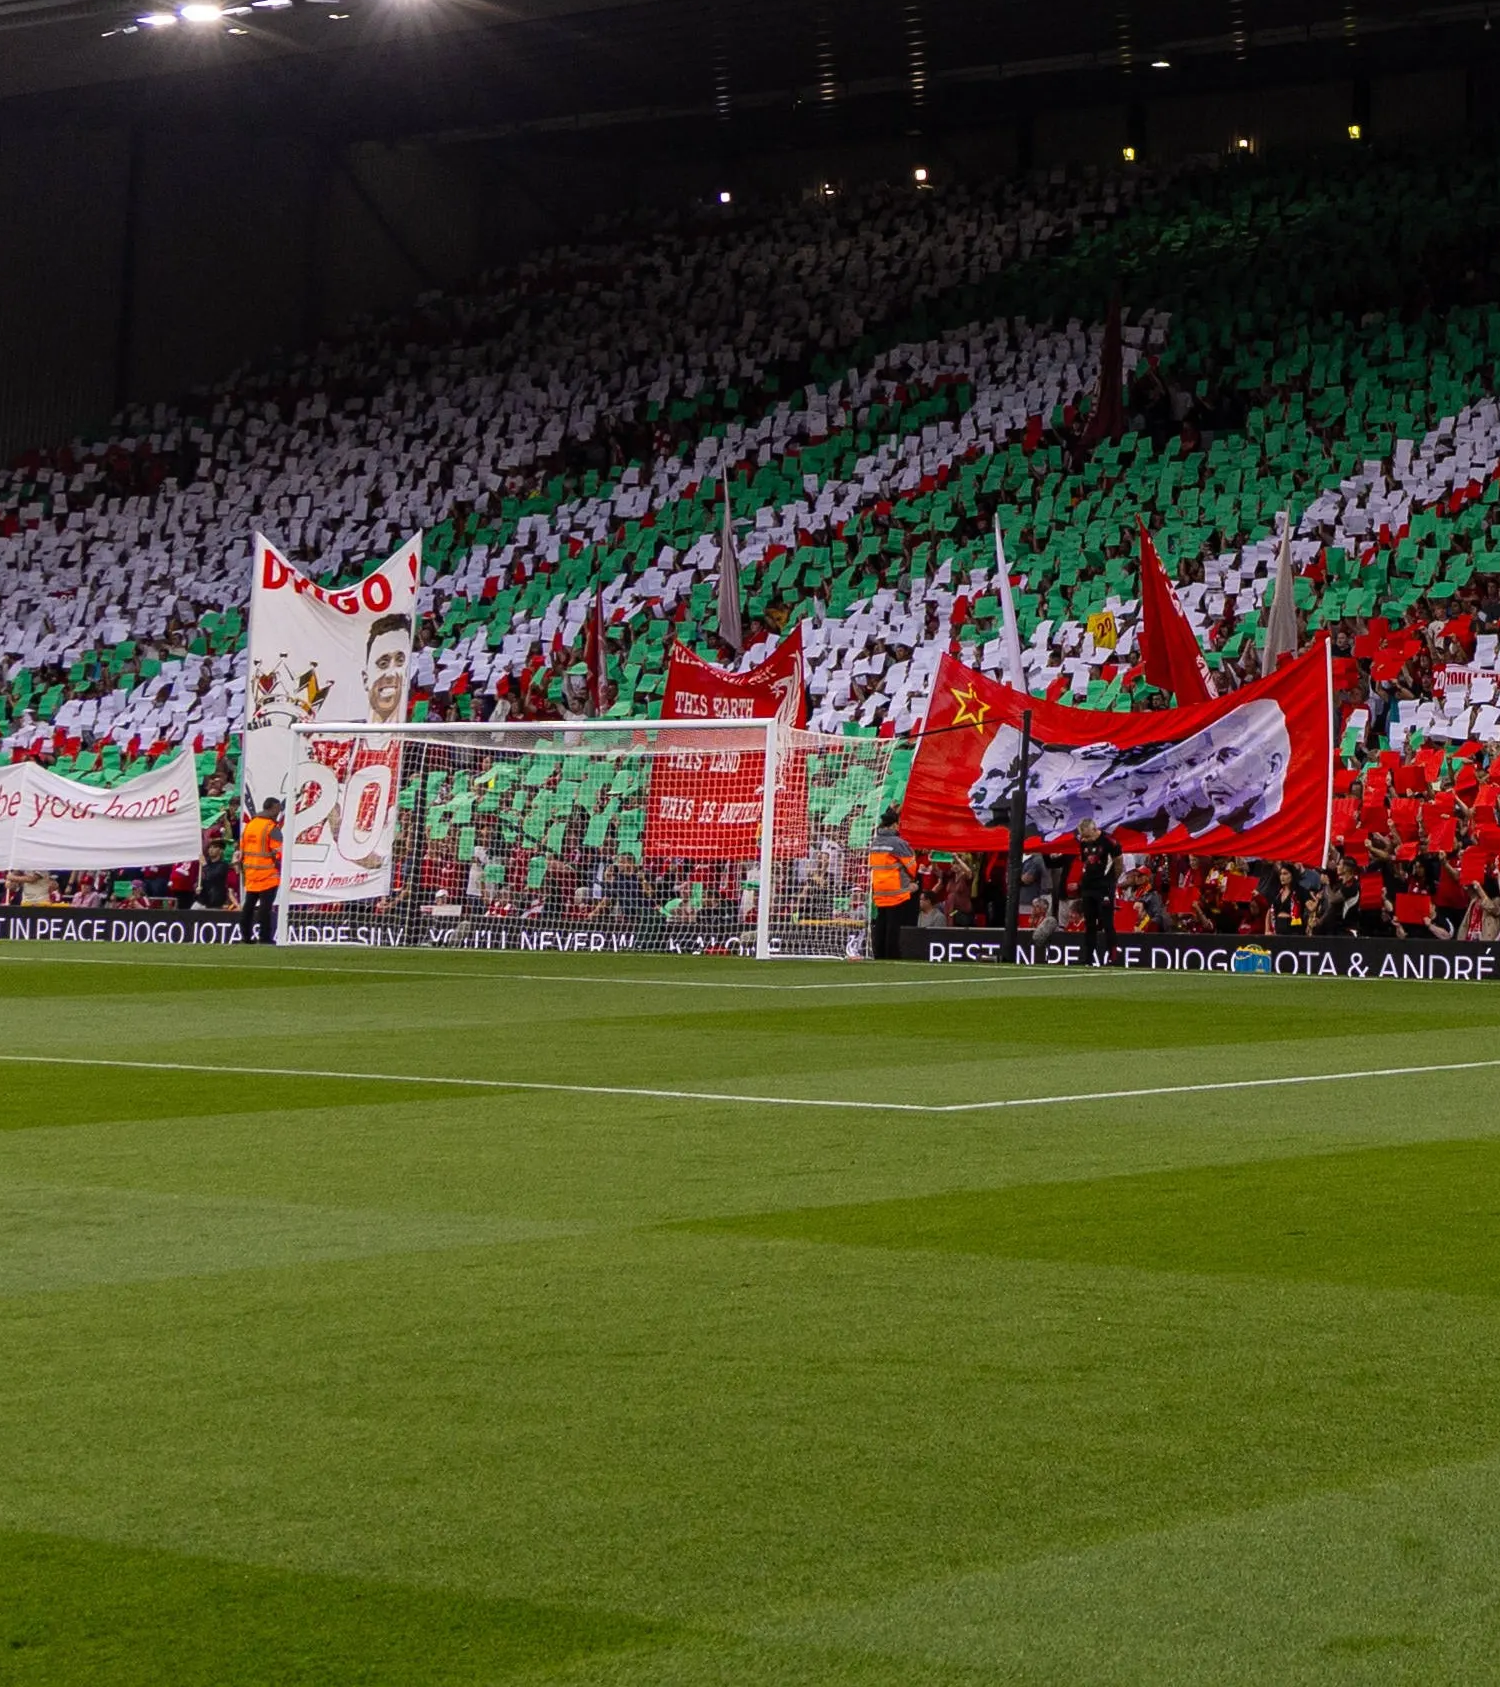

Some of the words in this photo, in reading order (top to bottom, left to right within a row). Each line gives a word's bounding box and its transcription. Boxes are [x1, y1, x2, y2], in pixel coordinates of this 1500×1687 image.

[1097, 617, 1113, 638] 20
[1433, 671, 1444, 690] 20
[675, 691, 708, 716] THIS
[712, 698, 754, 719] EARTH
[667, 745, 702, 769] THIS
[710, 752, 741, 773] LAND
[29, 792, 96, 827] your
[105, 788, 181, 819] home
[661, 797, 694, 821] THIS
[699, 801, 717, 823] IS
[289, 873, 323, 890] peão
[9, 918, 32, 940] IN
[36, 918, 106, 943] PEACE
[112, 921, 184, 944] DIOGO
[189, 922, 243, 945] JOTA
[274, 921, 350, 945] NDRÉ
[357, 926, 405, 947] SILV
[429, 928, 506, 950] YO'LL
[520, 931, 605, 952] NEVER
[929, 942, 1000, 962] REST
[1047, 946, 1141, 969] PEAE
[1275, 950, 1338, 975] OTA
[1347, 952, 1369, 978] &
[1379, 948, 1495, 981] ANDRÉ
